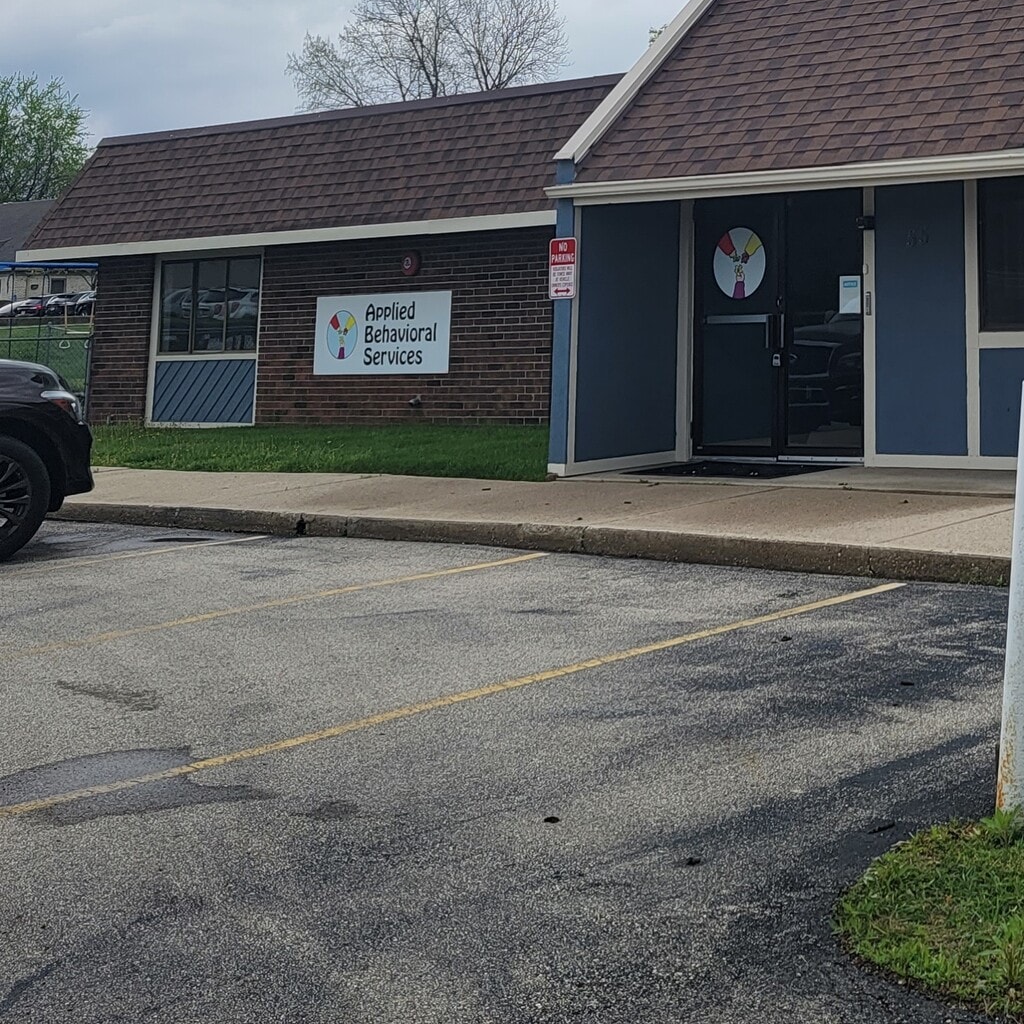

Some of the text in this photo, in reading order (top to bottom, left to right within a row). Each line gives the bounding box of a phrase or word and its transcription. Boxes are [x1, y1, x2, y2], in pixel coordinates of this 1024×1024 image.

[558, 242, 568, 252] NO
[551, 253, 575, 263] PARKING
[365, 301, 416, 321] Applied
[364, 323, 437, 343] Behavioral
[363, 347, 423, 366] Services
